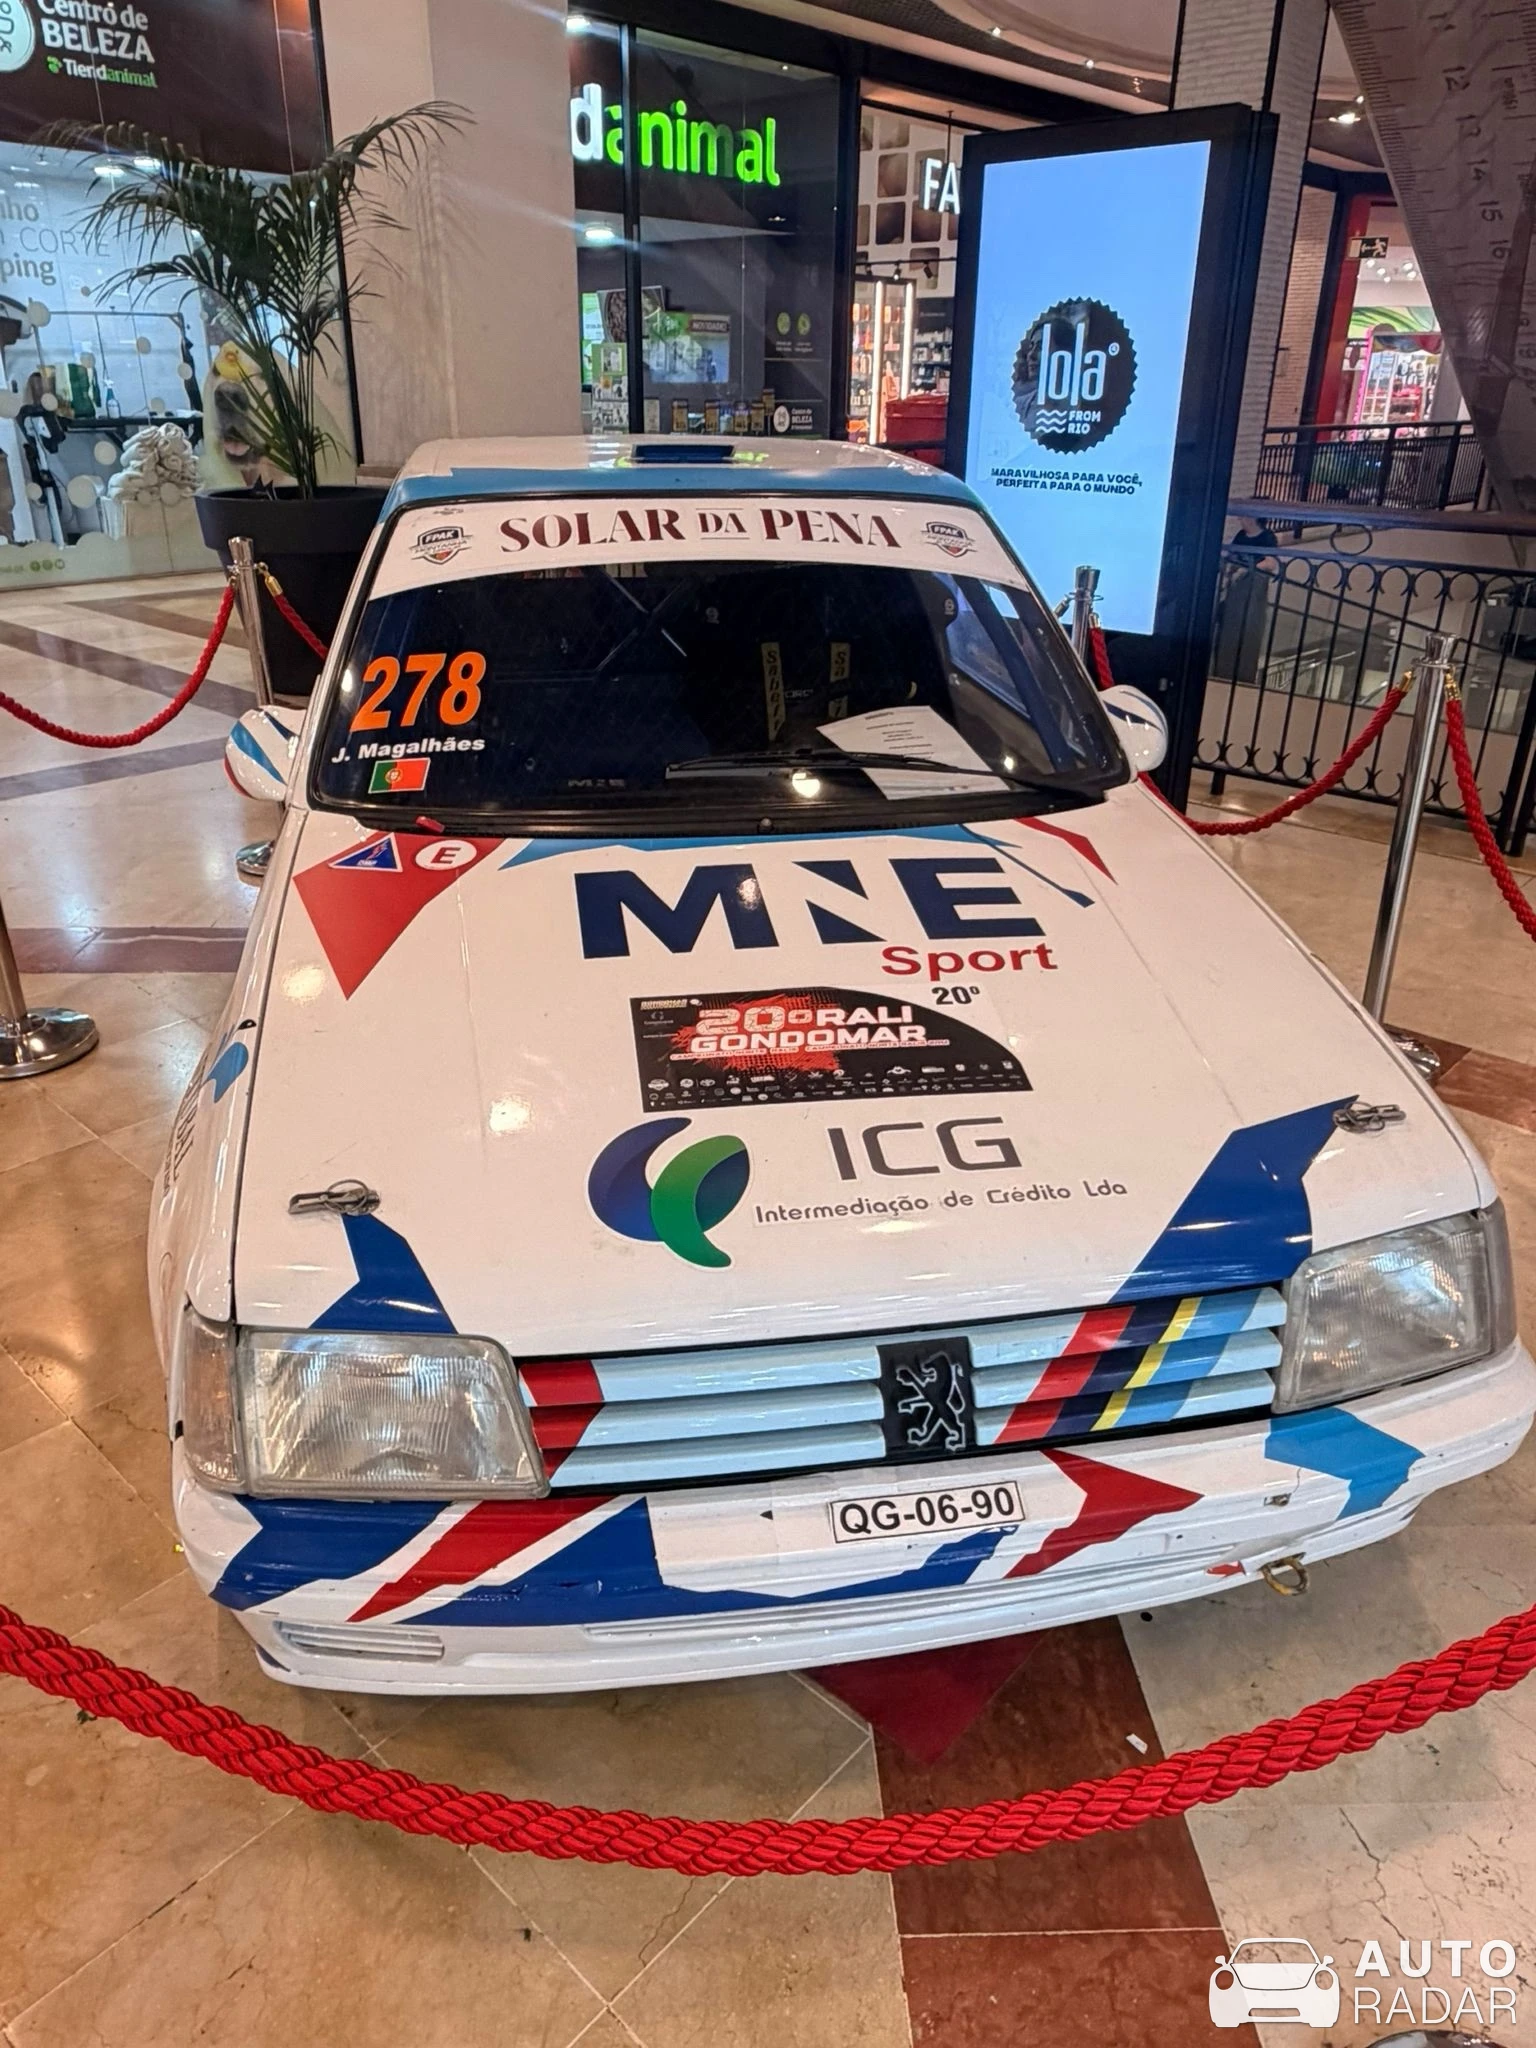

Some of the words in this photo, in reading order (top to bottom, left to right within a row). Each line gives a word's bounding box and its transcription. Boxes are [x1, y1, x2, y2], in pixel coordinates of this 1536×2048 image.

[37, 0, 118, 26] Centro
[120, 4, 149, 31] de
[40, 18, 156, 65] BELEZA
[1442, 66, 1470, 91] 12
[570, 83, 781, 186] danimal
[1456, 115, 1481, 137] 13
[1467, 159, 1488, 181] 14
[922, 158, 962, 215] FA
[1480, 201, 1503, 222] 15
[1489, 239, 1511, 259] 16
[1036, 322, 1107, 406] lola
[1068, 410, 1102, 422] FROM
[1068, 423, 1091, 434] RIO
[991, 468, 1070, 481] MARAVILHOSA
[1072, 472, 1104, 483] PARA
[1107, 473, 1143, 487] VOCÊ,
[996, 478, 1048, 490] PERFEITA
[1050, 480, 1081, 491] PARA
[1083, 482, 1092, 492] O
[1093, 483, 1135, 495] MUNDO
[425, 530, 455, 543] FPAK
[500, 508, 685, 553] SOLAR
[698, 511, 747, 535] DA
[763, 508, 902, 548] PENA
[934, 525, 960, 537] FPAK
[349, 651, 487, 733] 278
[331, 747, 350, 764] J.
[358, 736, 486, 759] Magalhães
[429, 847, 462, 865] E
[880, 943, 1059, 982] Sport
[931, 986, 981, 1005] 20º
[690, 1025, 927, 1053] GONDOMAR
[827, 1116, 1022, 1181] ICG
[756, 1193, 930, 1224] Intermediação
[943, 1190, 974, 1207] de
[987, 1182, 1071, 1205] Crédito
[1084, 1179, 1127, 1198] Lda
[839, 1487, 1015, 1535] QG-06-90
